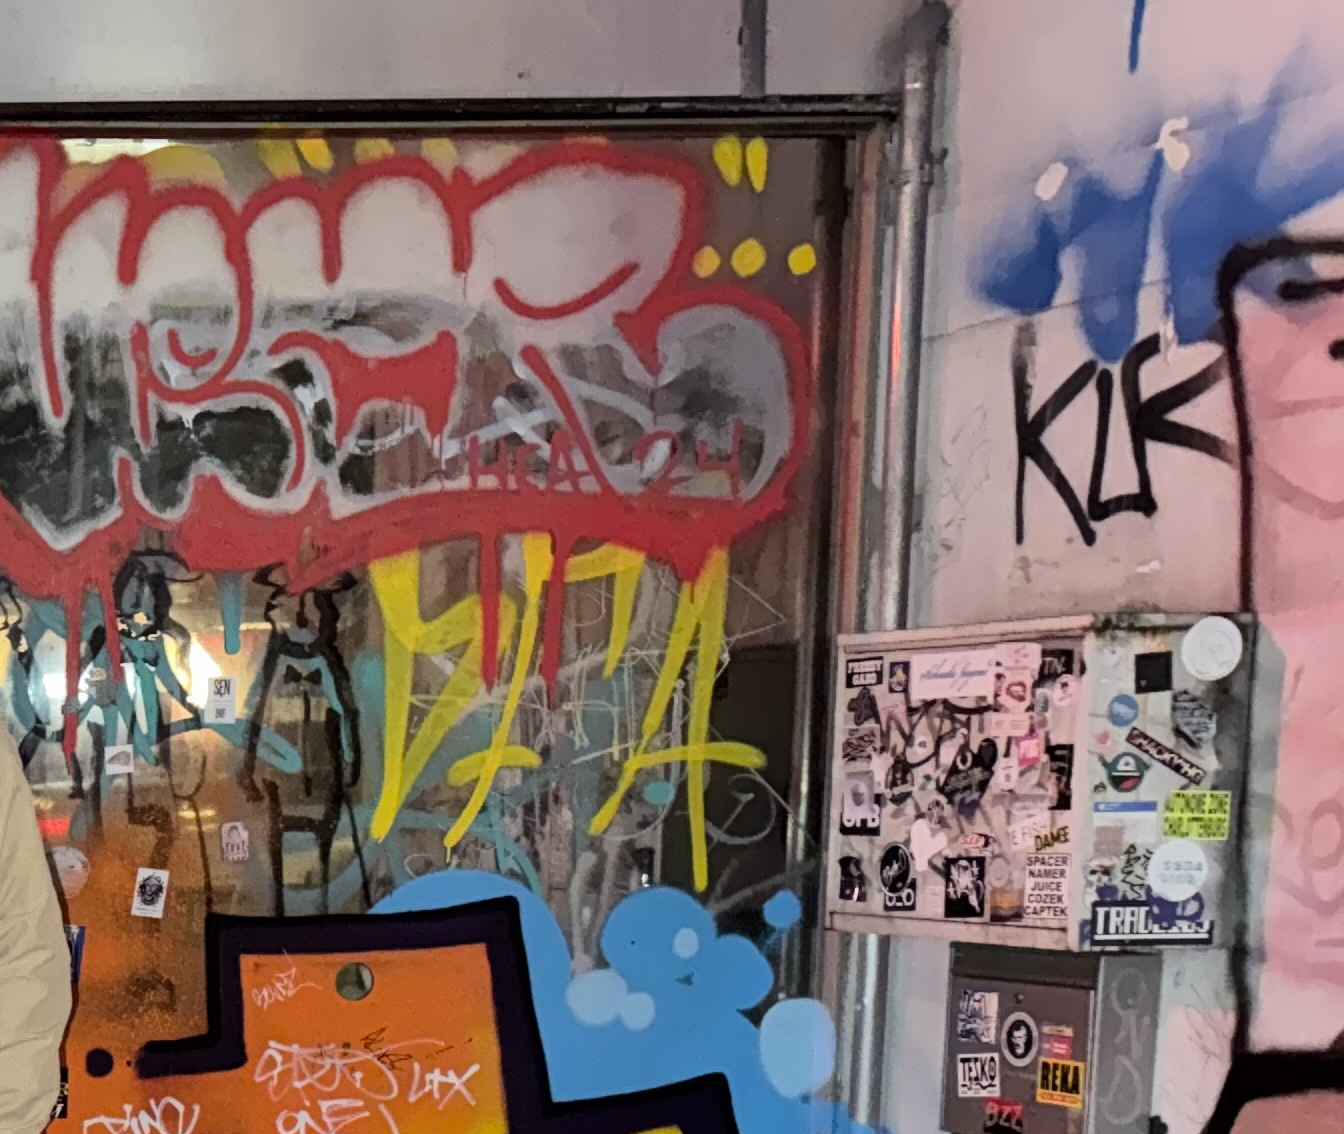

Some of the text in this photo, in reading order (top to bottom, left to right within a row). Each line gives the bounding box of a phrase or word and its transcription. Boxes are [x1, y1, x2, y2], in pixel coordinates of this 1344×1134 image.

[1026, 856, 1069, 867] SPACER
[1028, 868, 1067, 879] NAMER
[1031, 881, 1063, 892] JUICE
[1027, 893, 1065, 905] COZEK
[1023, 905, 1069, 917] CAPTEK
[1041, 1060, 1081, 1095] REKA
